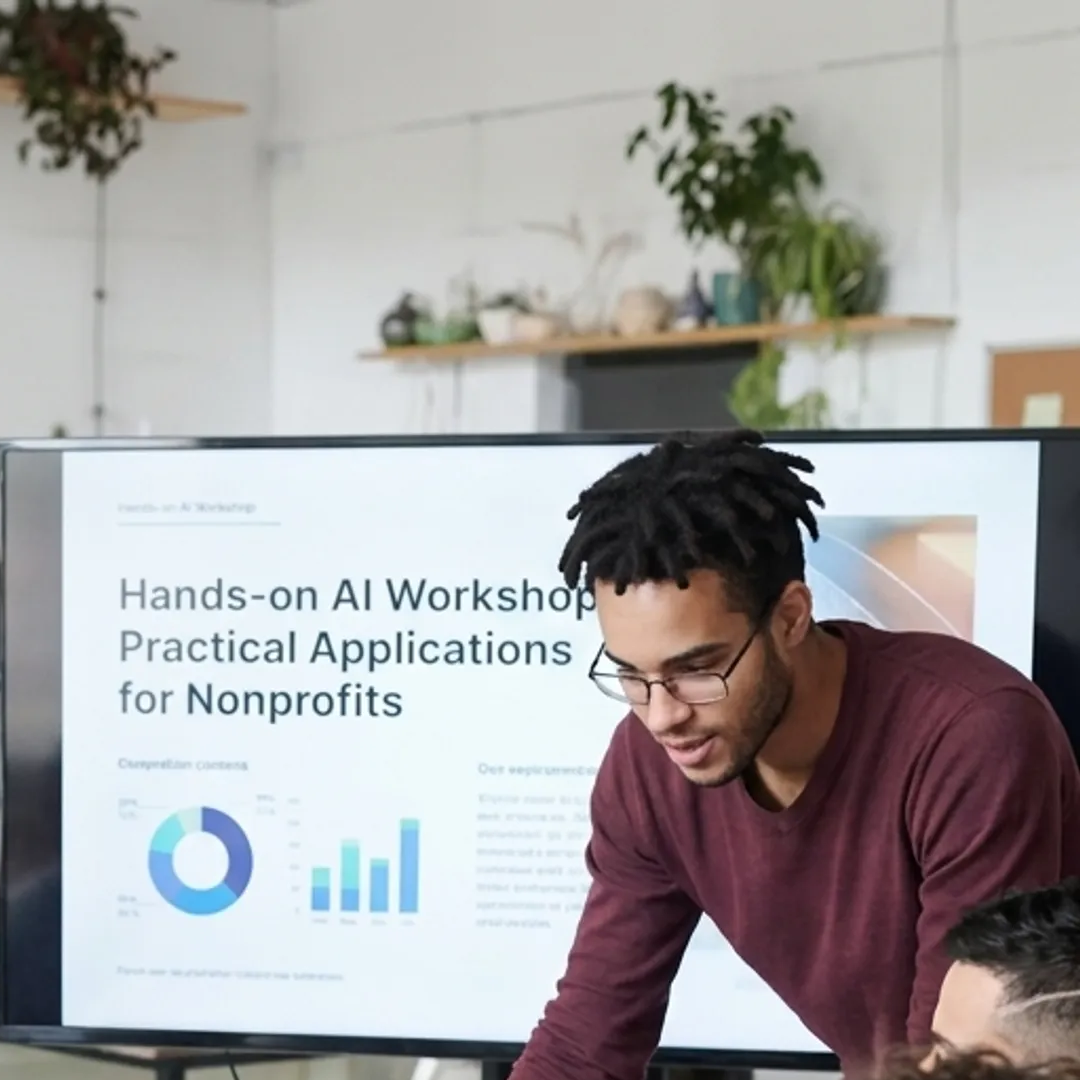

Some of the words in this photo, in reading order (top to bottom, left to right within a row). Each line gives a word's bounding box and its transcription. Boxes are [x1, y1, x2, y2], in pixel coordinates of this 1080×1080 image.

[120, 577, 318, 612] Hands-on
[331, 578, 371, 612] AI
[385, 577, 596, 621] Workshop
[120, 628, 297, 664] Practical
[309, 629, 573, 673] Applications
[118, 680, 175, 715] for
[187, 682, 403, 725] Nonprofits
